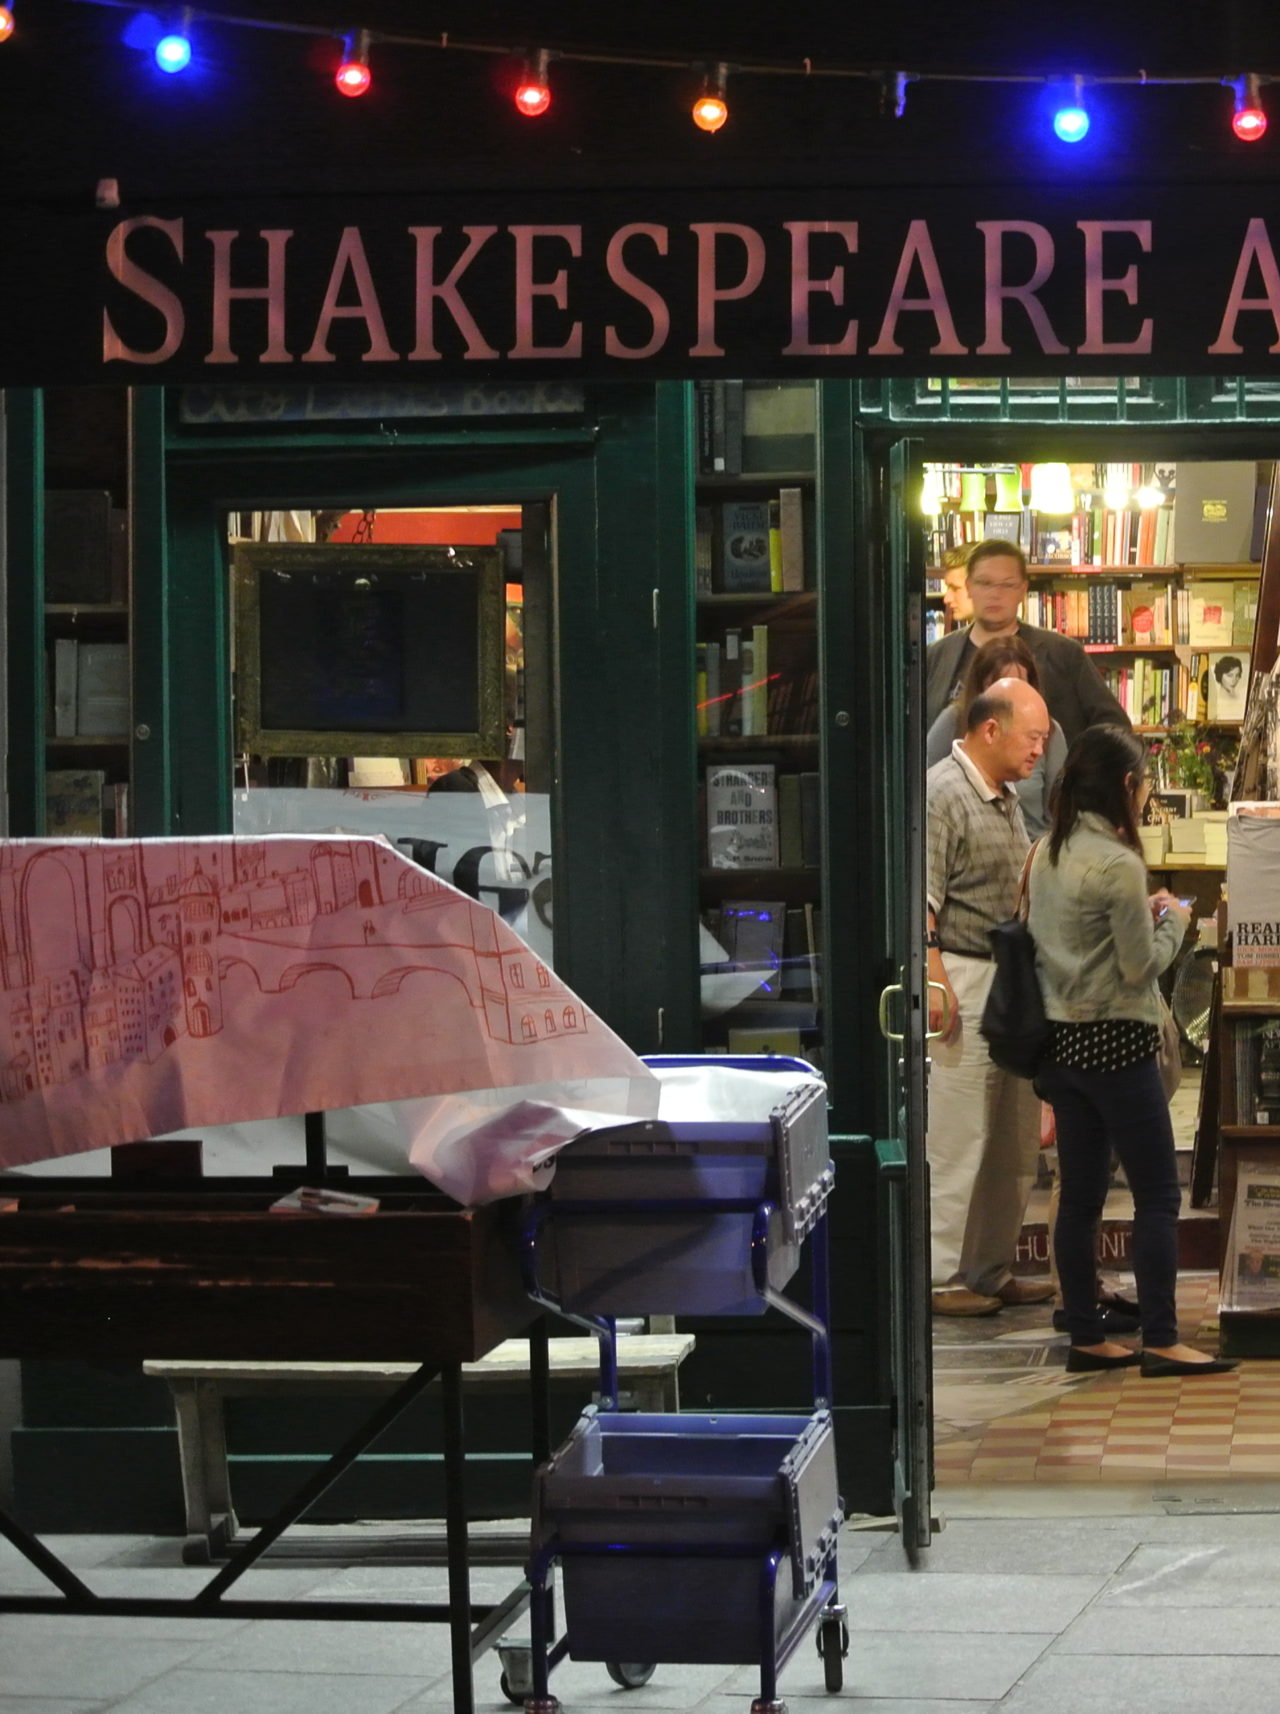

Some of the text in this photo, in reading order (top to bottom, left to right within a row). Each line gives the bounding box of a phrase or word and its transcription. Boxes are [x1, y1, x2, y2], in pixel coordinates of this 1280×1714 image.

[102, 215, 1155, 364] SHAKESPEARE
[730, 792, 752, 808] AND
[716, 809, 773, 825] BROTHERS
